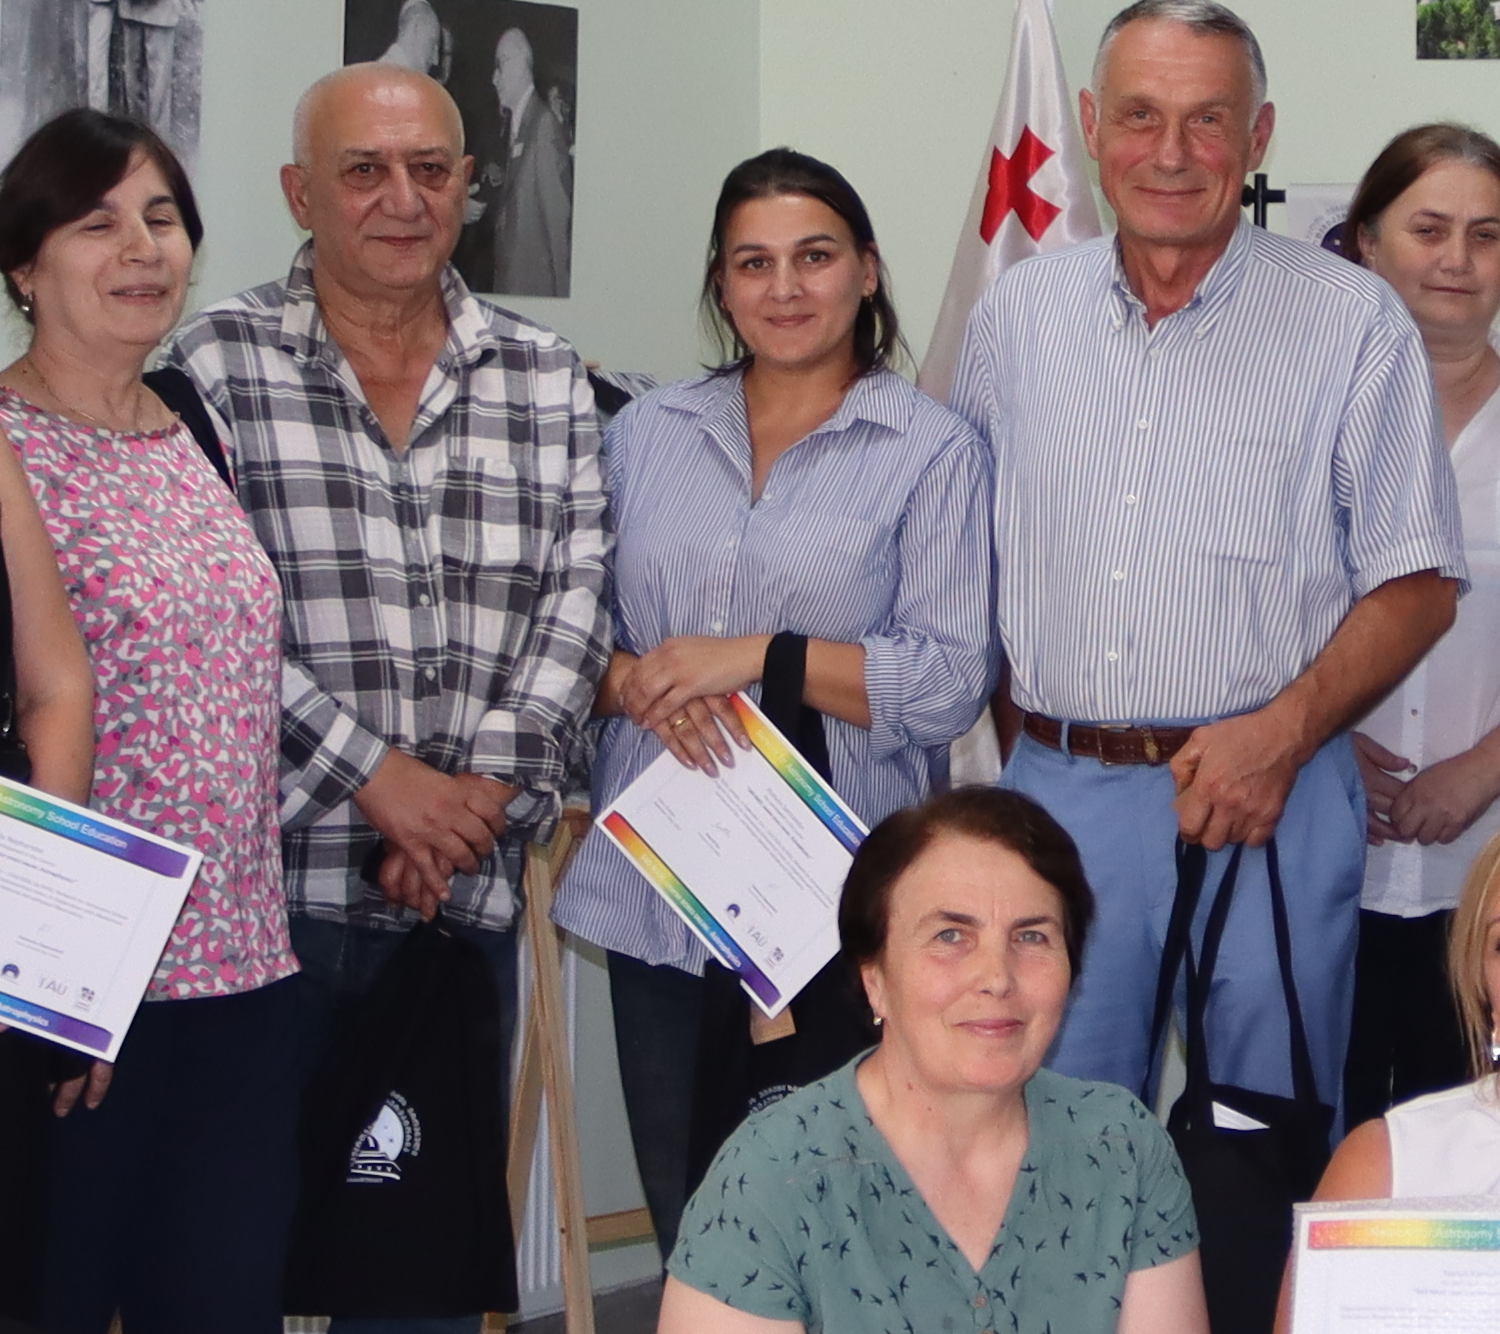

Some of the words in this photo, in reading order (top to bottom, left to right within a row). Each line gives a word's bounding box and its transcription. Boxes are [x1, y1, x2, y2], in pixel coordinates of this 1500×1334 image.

[46, 810, 80, 831] School
[80, 823, 128, 849] Education
[786, 763, 816, 798] Astronomy
[813, 793, 836, 818] School
[831, 814, 861, 848] Education
